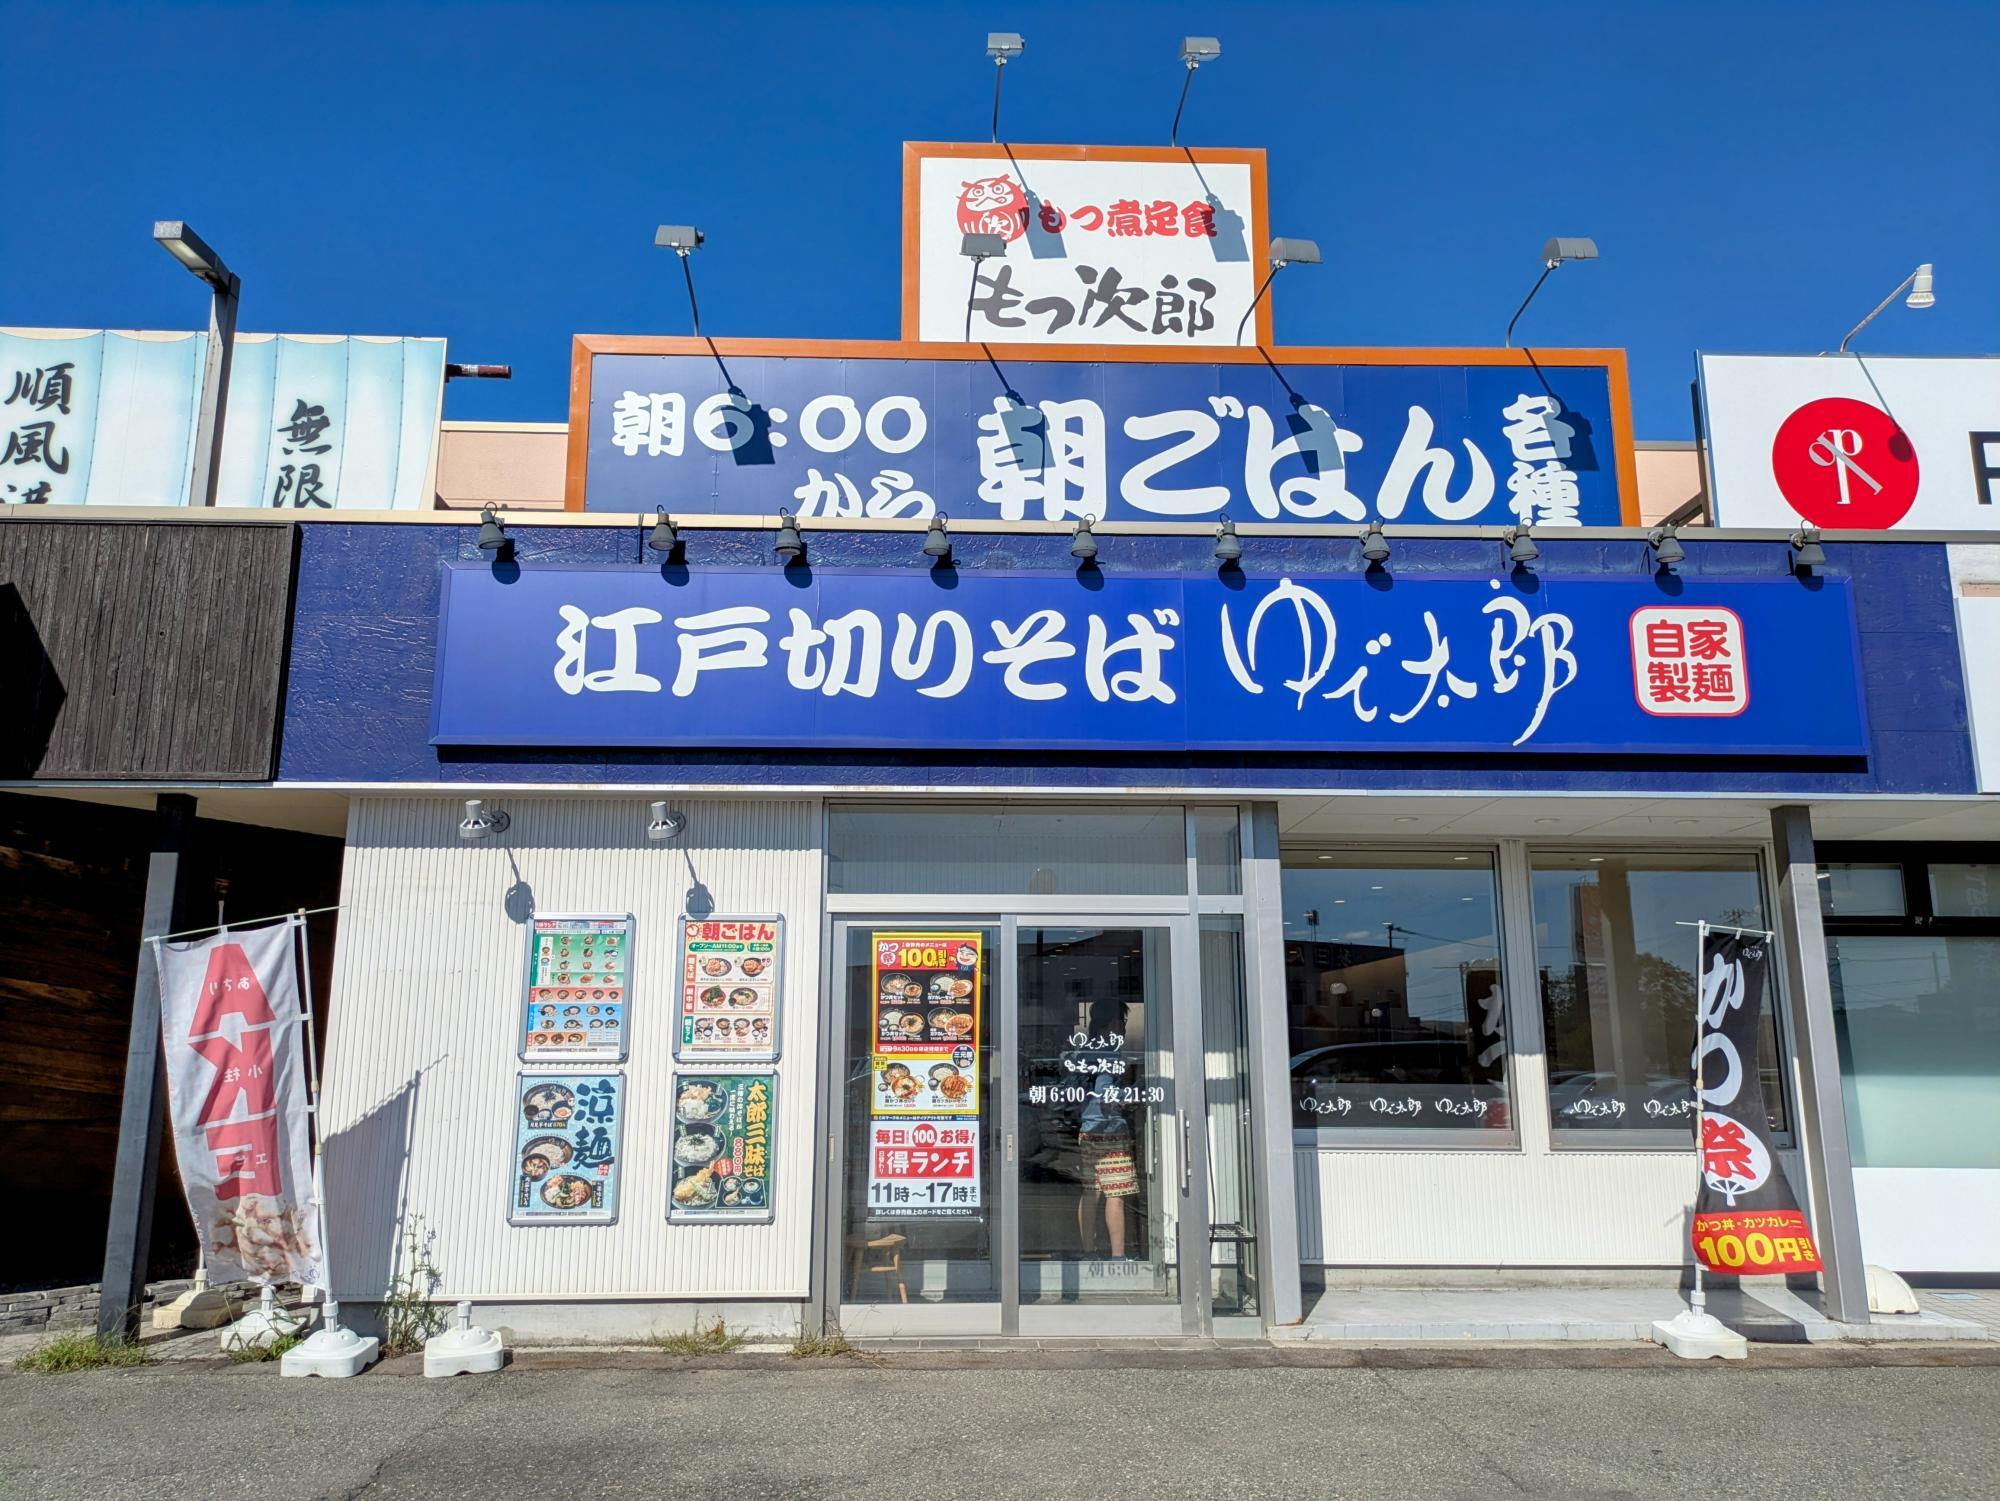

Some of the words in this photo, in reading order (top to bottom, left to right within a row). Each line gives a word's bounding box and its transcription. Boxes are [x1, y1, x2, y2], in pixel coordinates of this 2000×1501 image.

[1039, 199, 1218, 238] もつ煮定食
[970, 264, 1217, 338] もつ次郎
[612, 390, 928, 456] 朝6:00
[976, 394, 1496, 523] 朝ごはん
[1502, 393, 1583, 527] 各種
[794, 468, 936, 519] から
[553, 604, 1180, 705] 江戸切りそば
[1221, 577, 1578, 747] ゆで太郎
[702, 923, 775, 941] 朝ごはん
[1068, 1032, 1124, 1052] ゆで太郎
[1299, 1096, 1352, 1119] ゆで太郎
[1369, 1096, 1423, 1119] ゆで太郎
[1435, 1096, 1488, 1119] ゆで太郎
[1572, 1097, 1626, 1119] ゆで太郎
[1696, 1216, 1802, 1232] かつ丼・カツカレー
